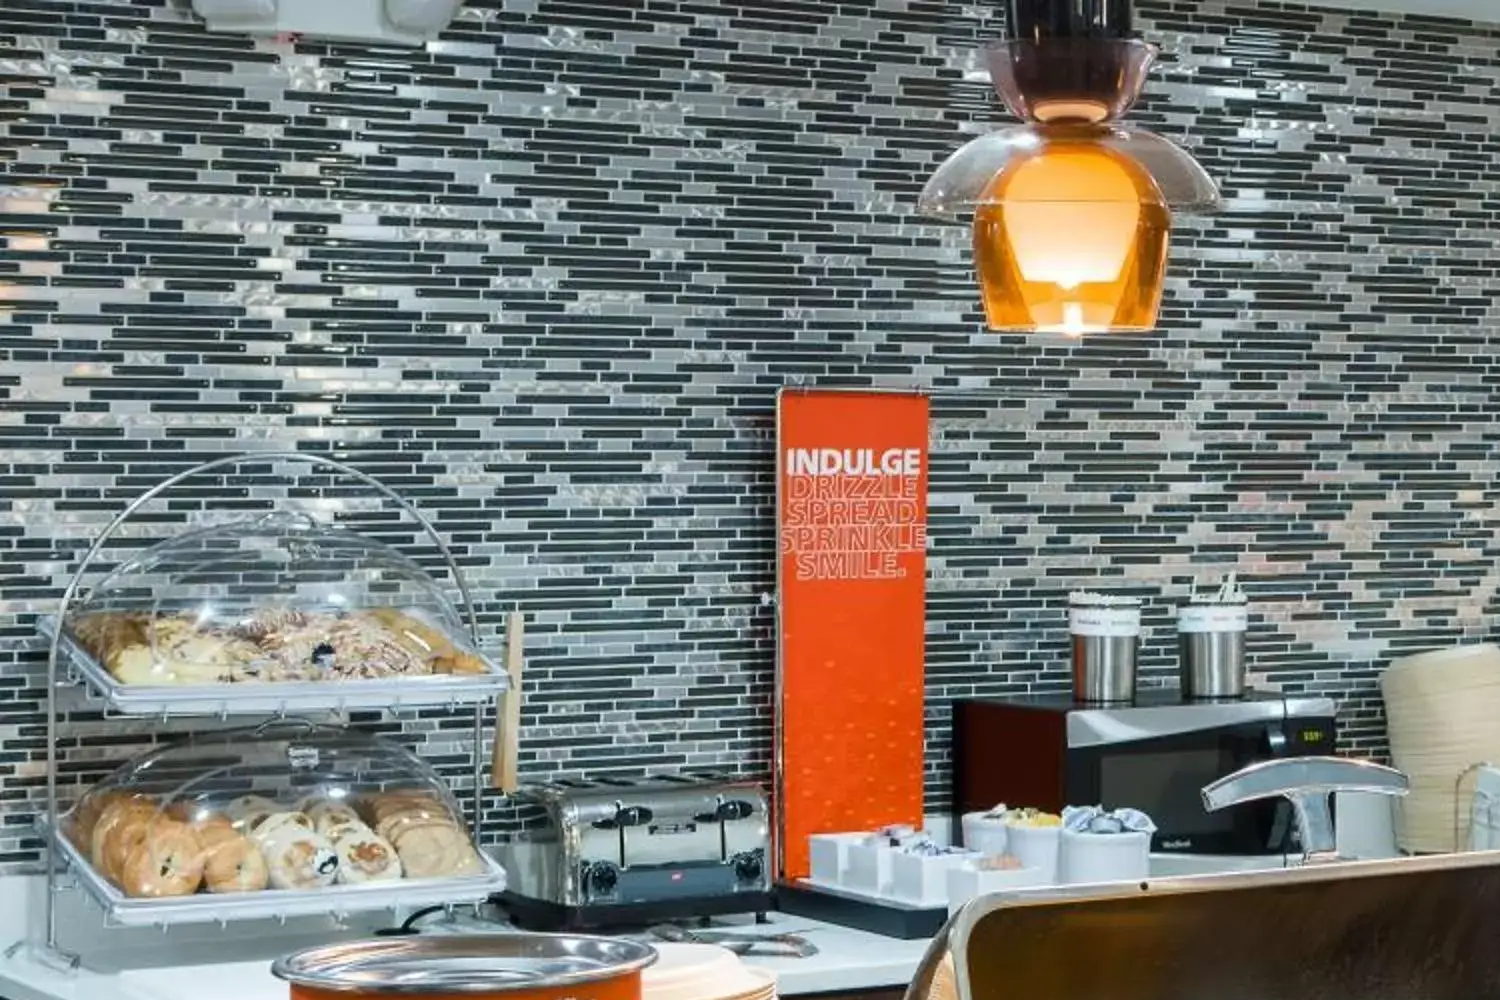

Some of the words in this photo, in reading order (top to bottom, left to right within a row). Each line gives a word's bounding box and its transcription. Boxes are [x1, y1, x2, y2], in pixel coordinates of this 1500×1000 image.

[787, 448, 921, 476] INDULGE
[789, 474, 918, 500] DRIZZLE
[787, 499, 918, 525] SPREAD
[782, 524, 926, 553] SPRINKLE
[796, 551, 907, 580] SMILE.
